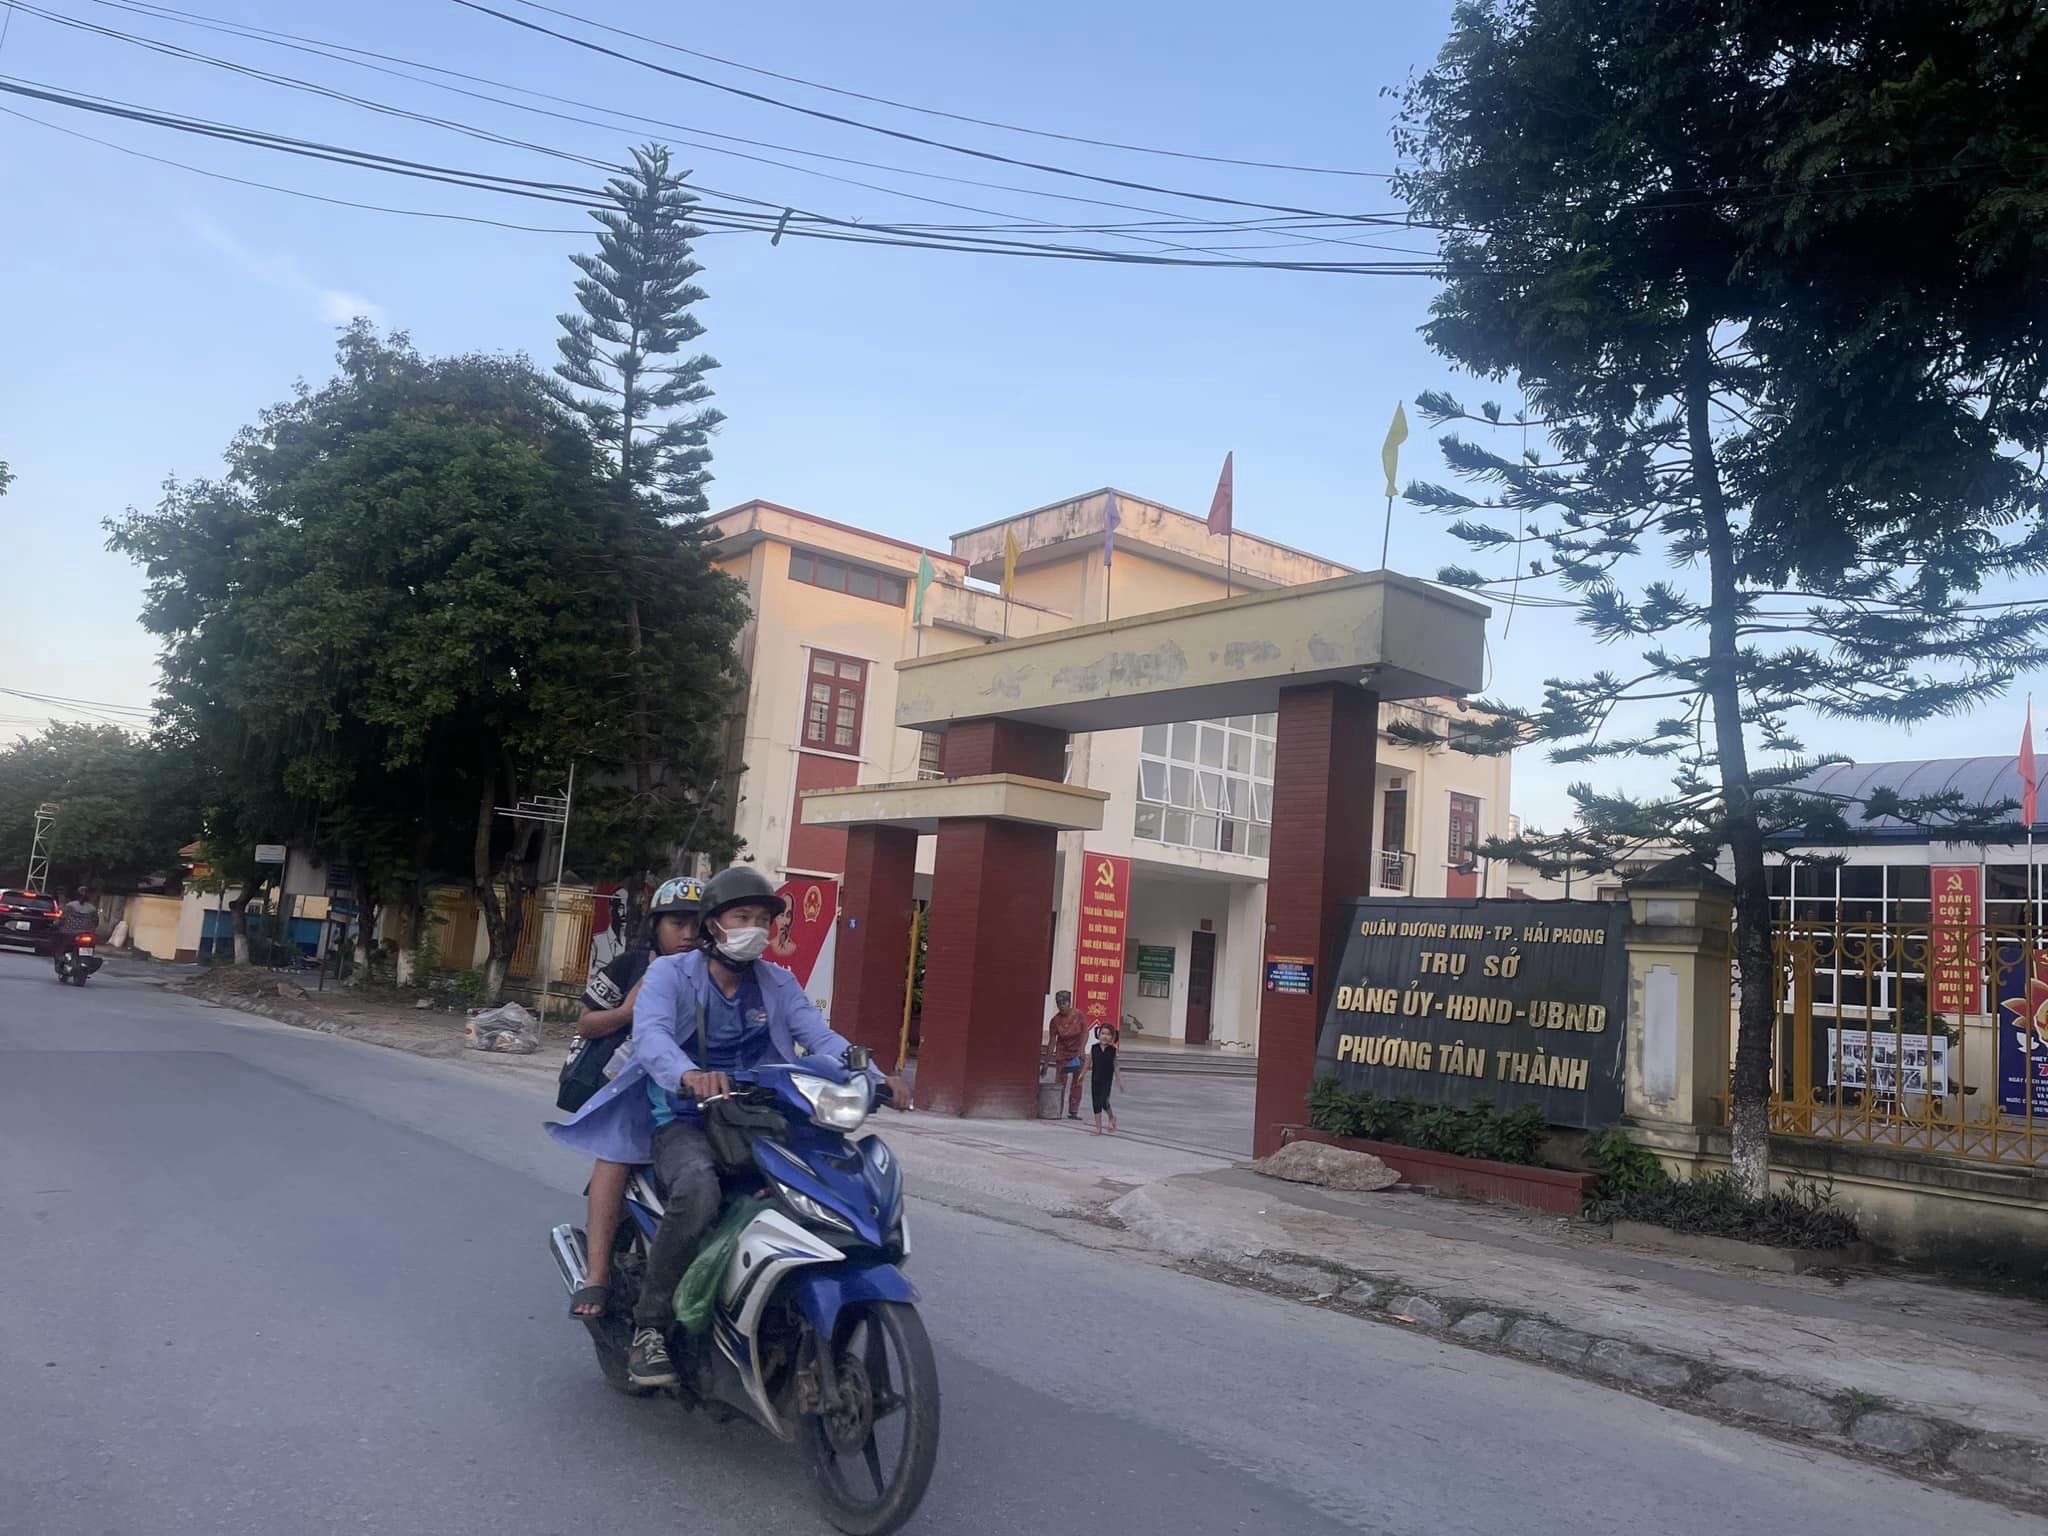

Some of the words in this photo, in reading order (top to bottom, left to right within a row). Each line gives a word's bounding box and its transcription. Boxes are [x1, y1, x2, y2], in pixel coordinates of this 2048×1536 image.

[1400, 922, 1446, 938] DƯƠNG
[1450, 924, 1484, 940] KINH
[1523, 921, 1549, 942] HẢI
[1420, 952, 1466, 980] TRỤ
[1483, 946, 1521, 978] SỞ
[1939, 983, 1974, 993] MUN
[1529, 1000, 1606, 1032] UBND
[1439, 1040, 1486, 1078] TÂN
[1496, 1046, 1589, 1091] THÀNH
